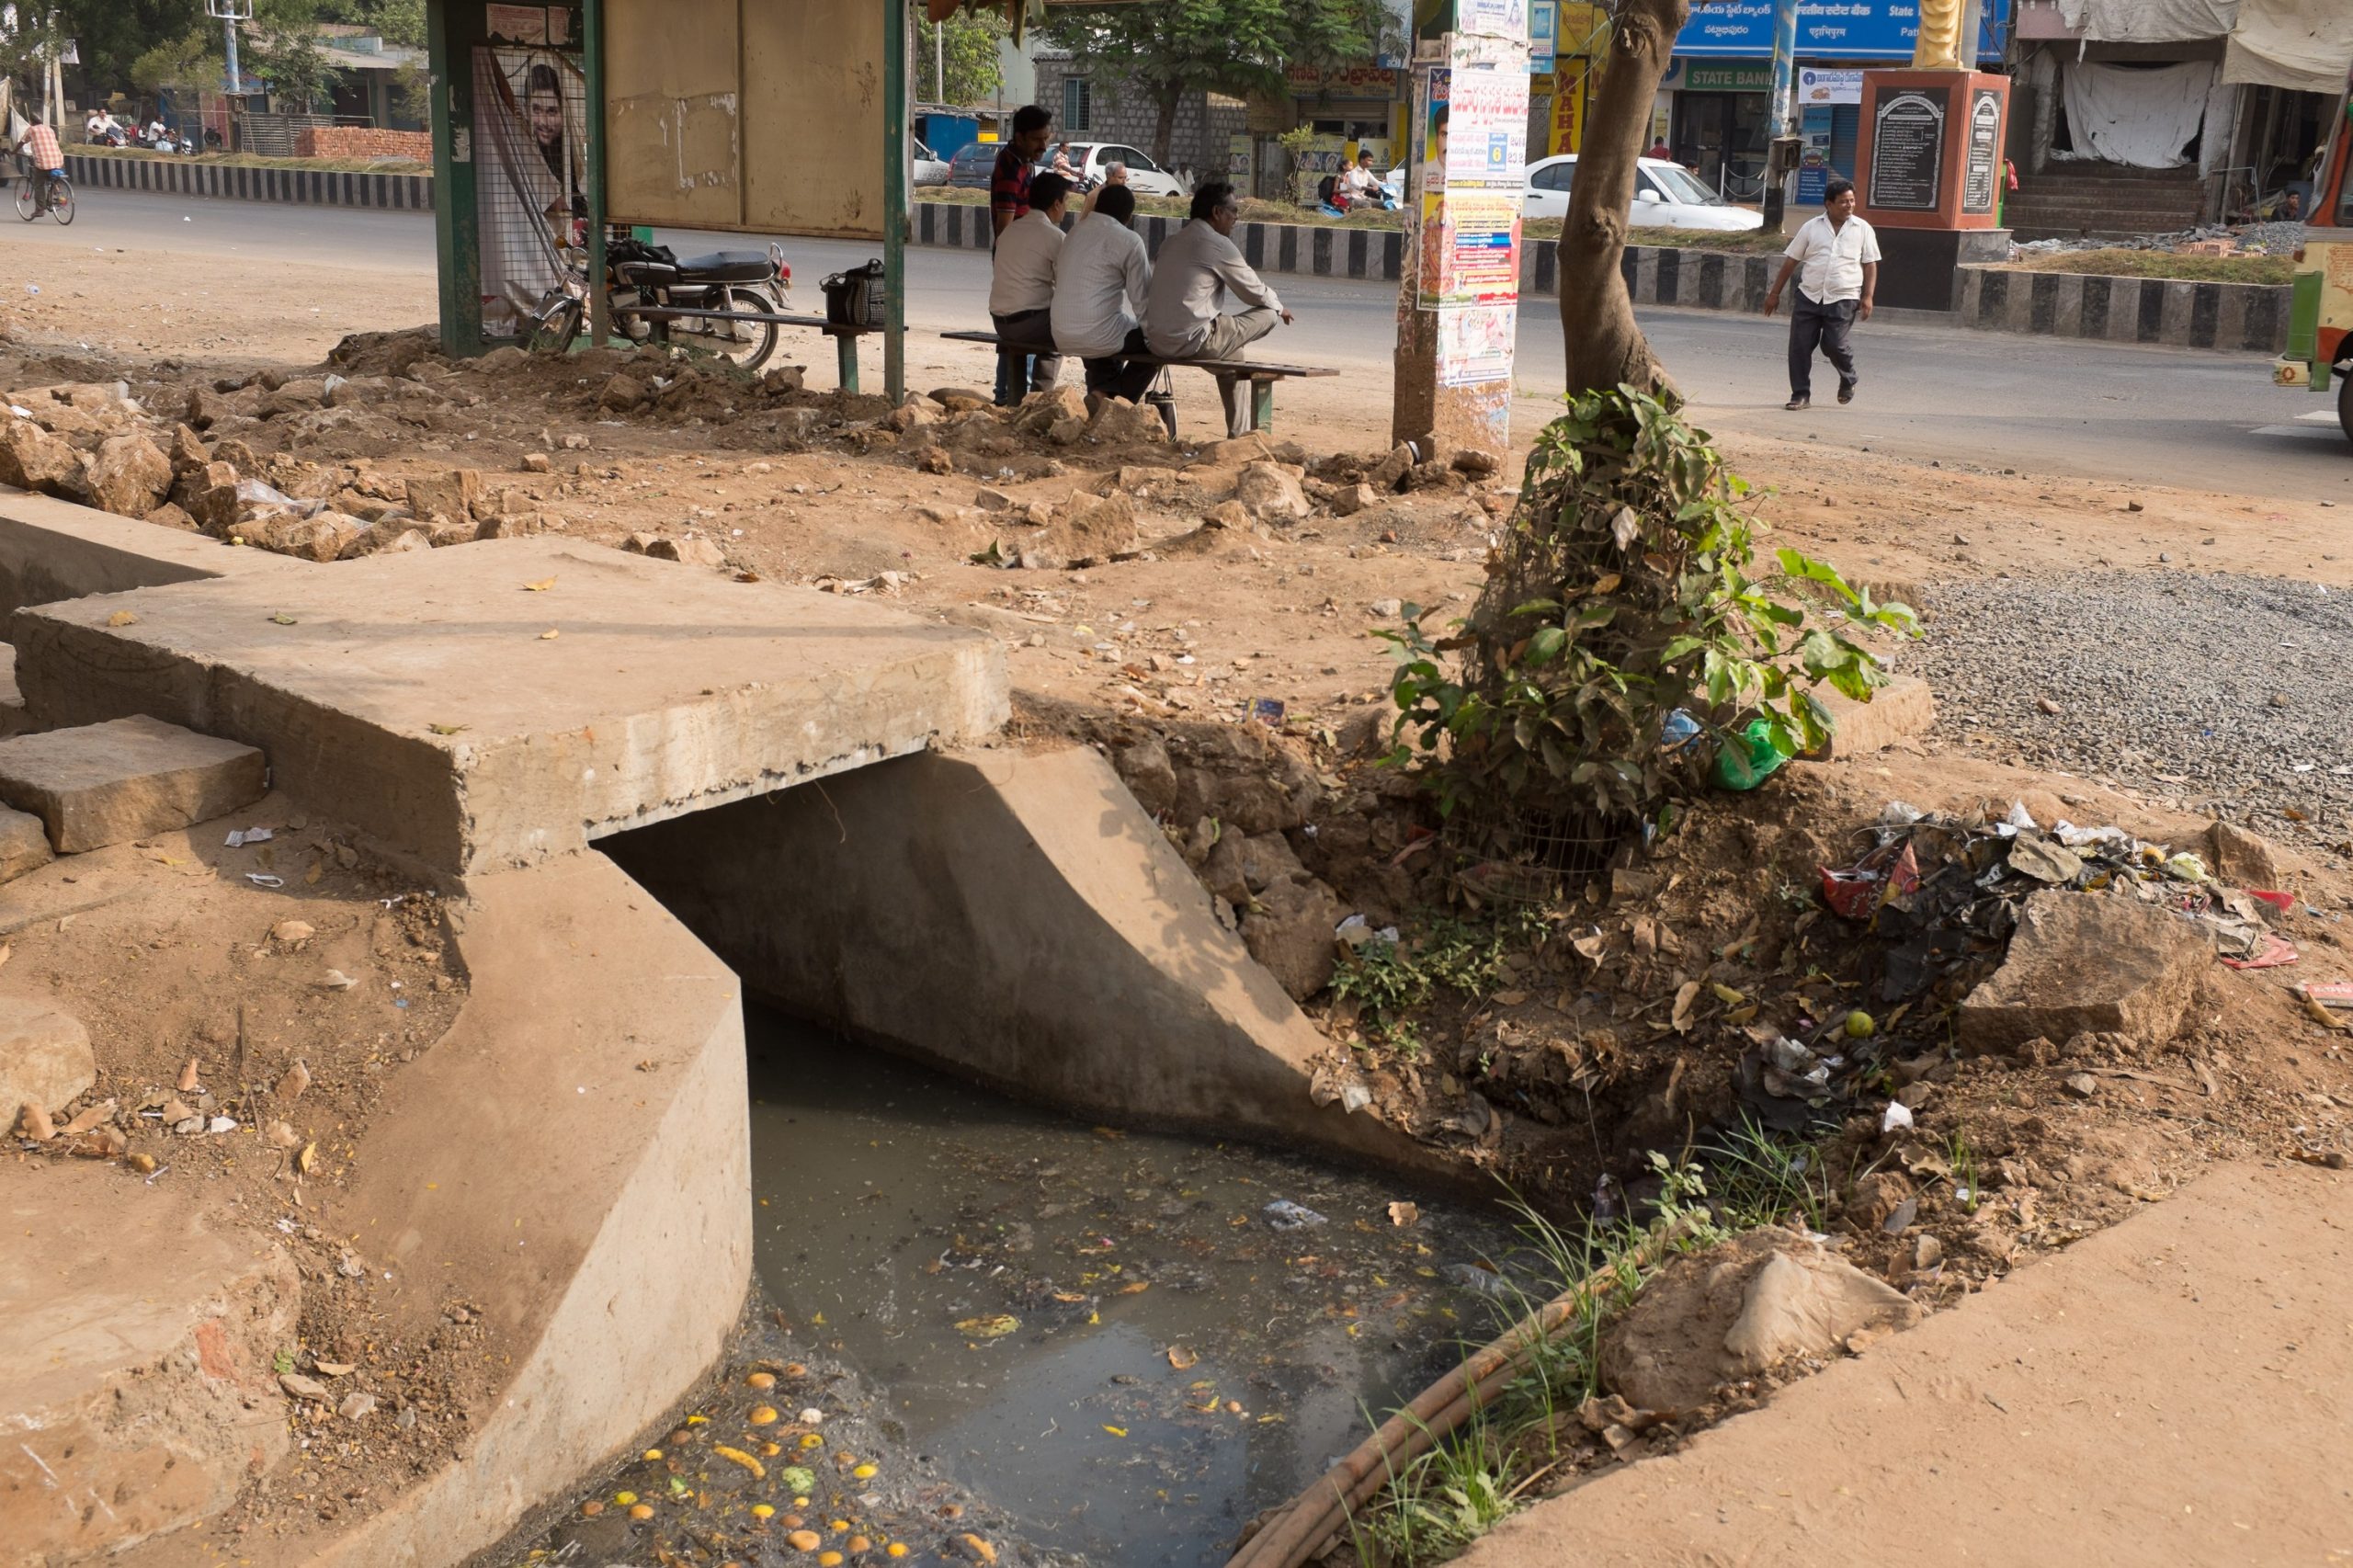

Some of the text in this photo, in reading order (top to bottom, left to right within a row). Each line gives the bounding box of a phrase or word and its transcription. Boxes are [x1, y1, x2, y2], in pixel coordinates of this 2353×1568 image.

[1889, 6, 1914, 17] State
[1692, 71, 1773, 85] STATE BANK
